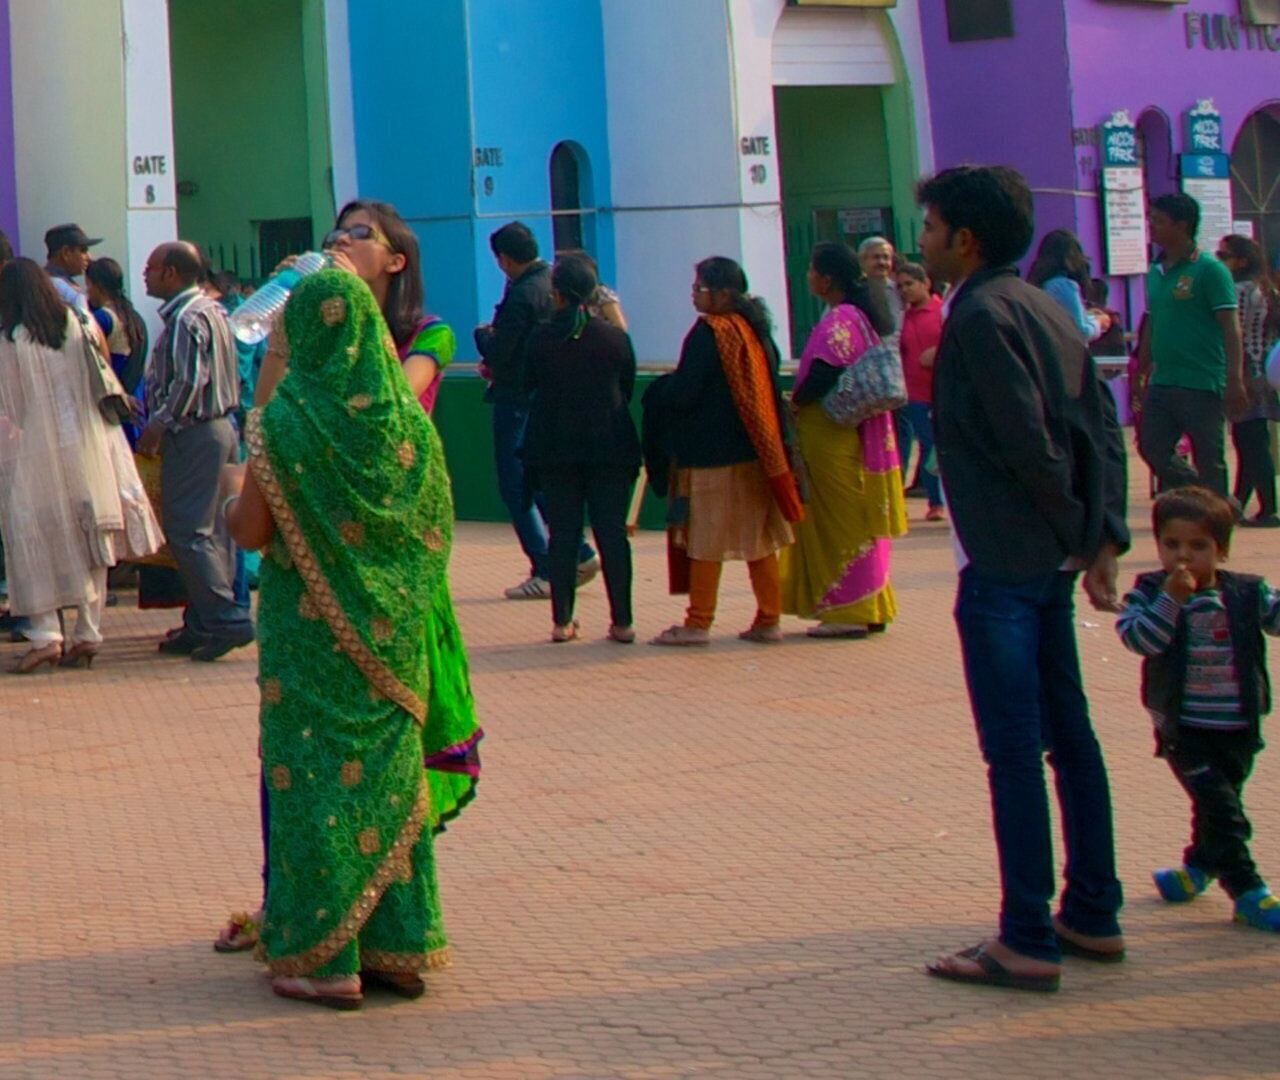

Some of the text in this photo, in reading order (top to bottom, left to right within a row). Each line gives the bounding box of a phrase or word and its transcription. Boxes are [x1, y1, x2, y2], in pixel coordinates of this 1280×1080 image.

[1184, 12, 1239, 50] FUN
[741, 135, 770, 157] GATE
[133, 155, 167, 175] GATE
[475, 147, 503, 168] GATE
[144, 184, 156, 204] 8
